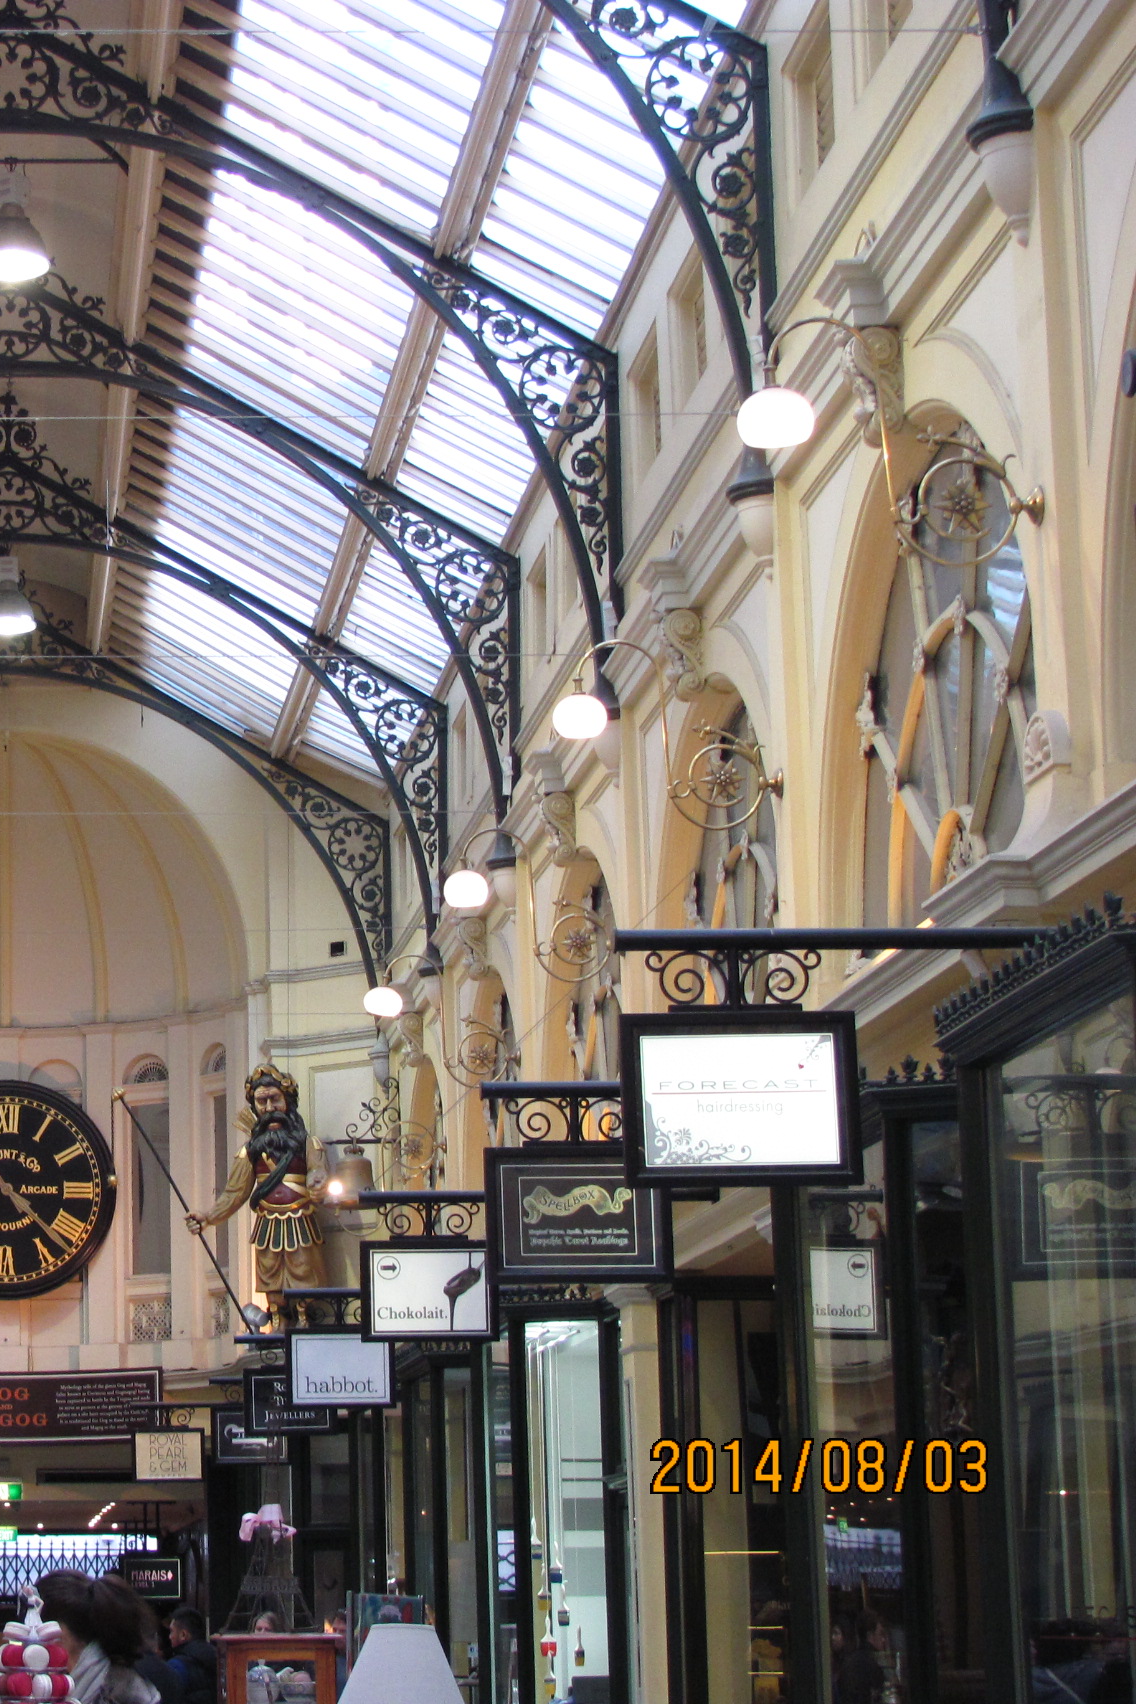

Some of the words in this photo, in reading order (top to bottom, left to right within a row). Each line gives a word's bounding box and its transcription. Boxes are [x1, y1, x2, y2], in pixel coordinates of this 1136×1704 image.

[659, 1079, 818, 1091] FORECAST
[697, 1099, 783, 1115] hairdressing
[19, 1184, 59, 1194] ARCADE
[539, 1189, 595, 1212] SPELLBOX
[377, 1306, 448, 1320] Chokolait.
[305, 1376, 378, 1394] habbot.
[149, 1433, 187, 1446] ROYAL
[149, 1446, 188, 1460] PEARL
[160, 1460, 187, 1472] GEM
[131, 1570, 167, 1581] MARAIS
